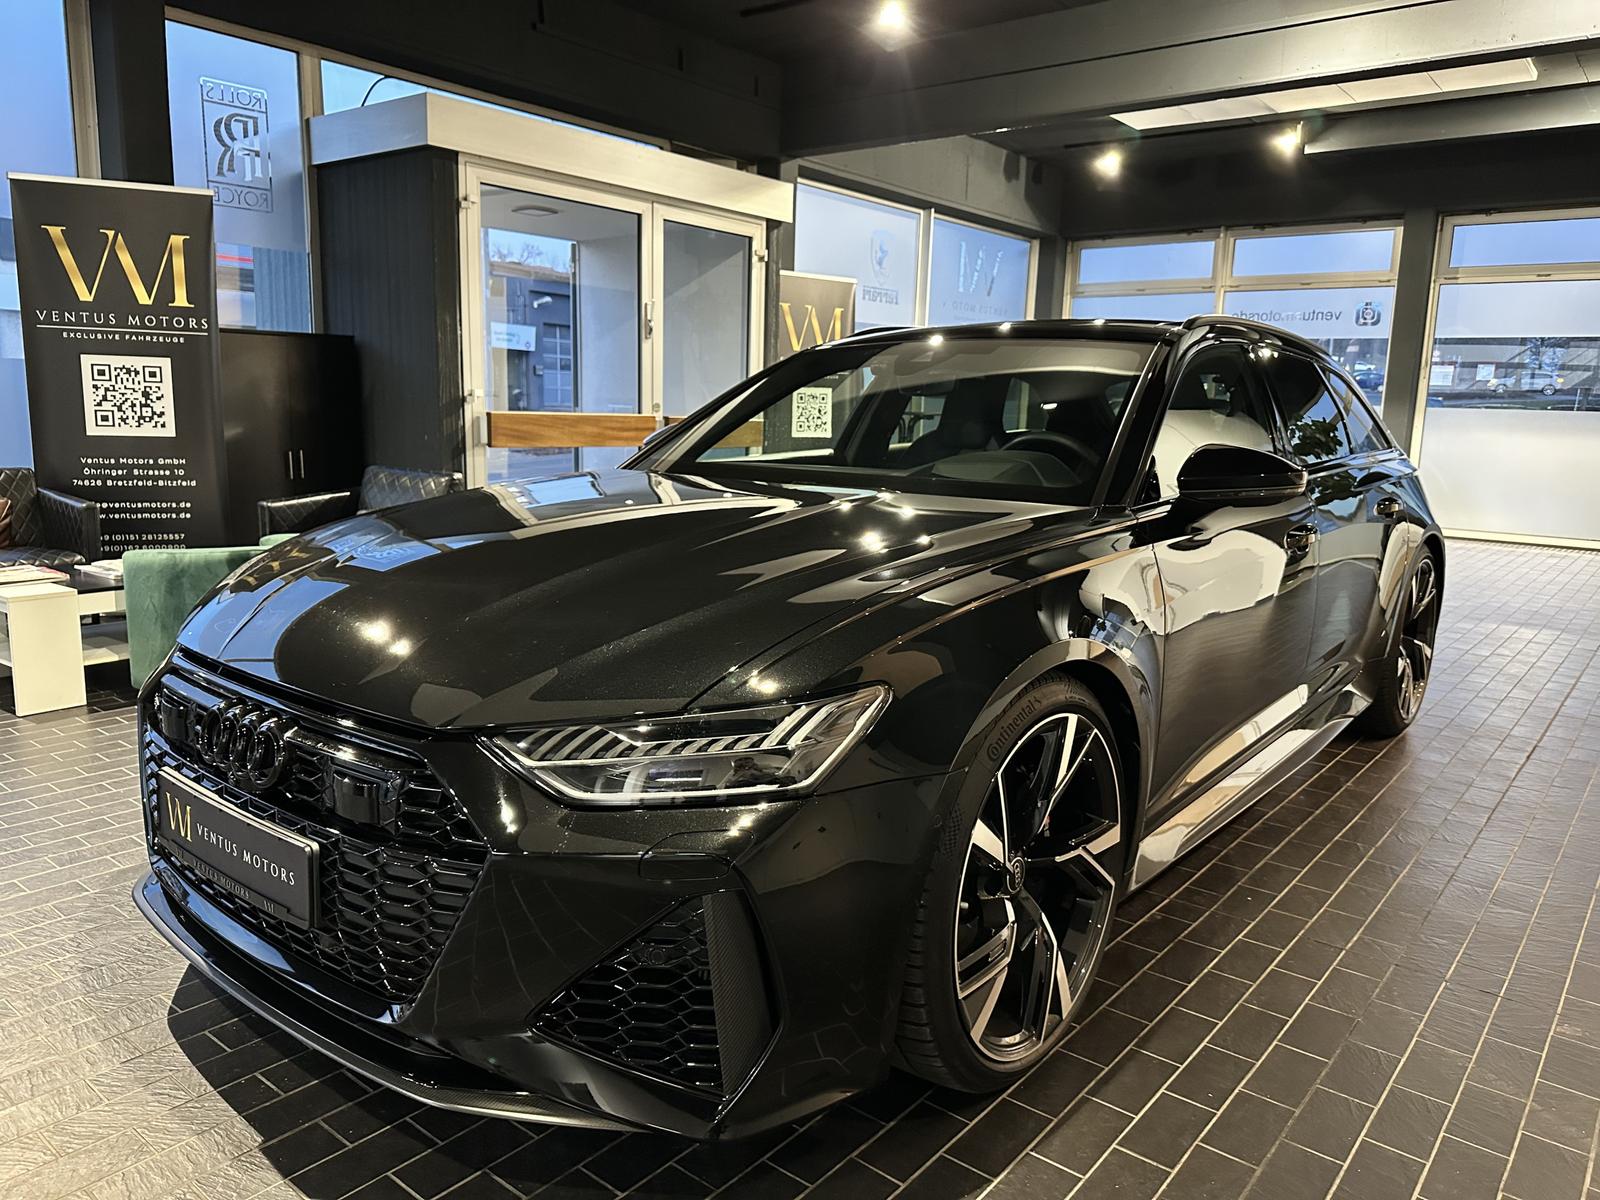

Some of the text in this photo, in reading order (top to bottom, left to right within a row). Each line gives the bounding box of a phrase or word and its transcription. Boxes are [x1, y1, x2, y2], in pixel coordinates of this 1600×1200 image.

[41, 225, 194, 307] VM
[36, 309, 209, 330] VENTUS MOTORS
[63, 331, 185, 344] EXCLUSIVE FAHRZEUGE
[80, 457, 186, 466] Ventus Motors GmbH
[133, 468, 170, 476] Strasse
[72, 479, 102, 487] 74626
[96, 501, 192, 509] o@ventusmotors.de
[99, 512, 192, 520] w.ventusmotors.de
[987, 699, 1038, 761] Continental
[165, 791, 295, 887] VM VENTUS MOTORS
